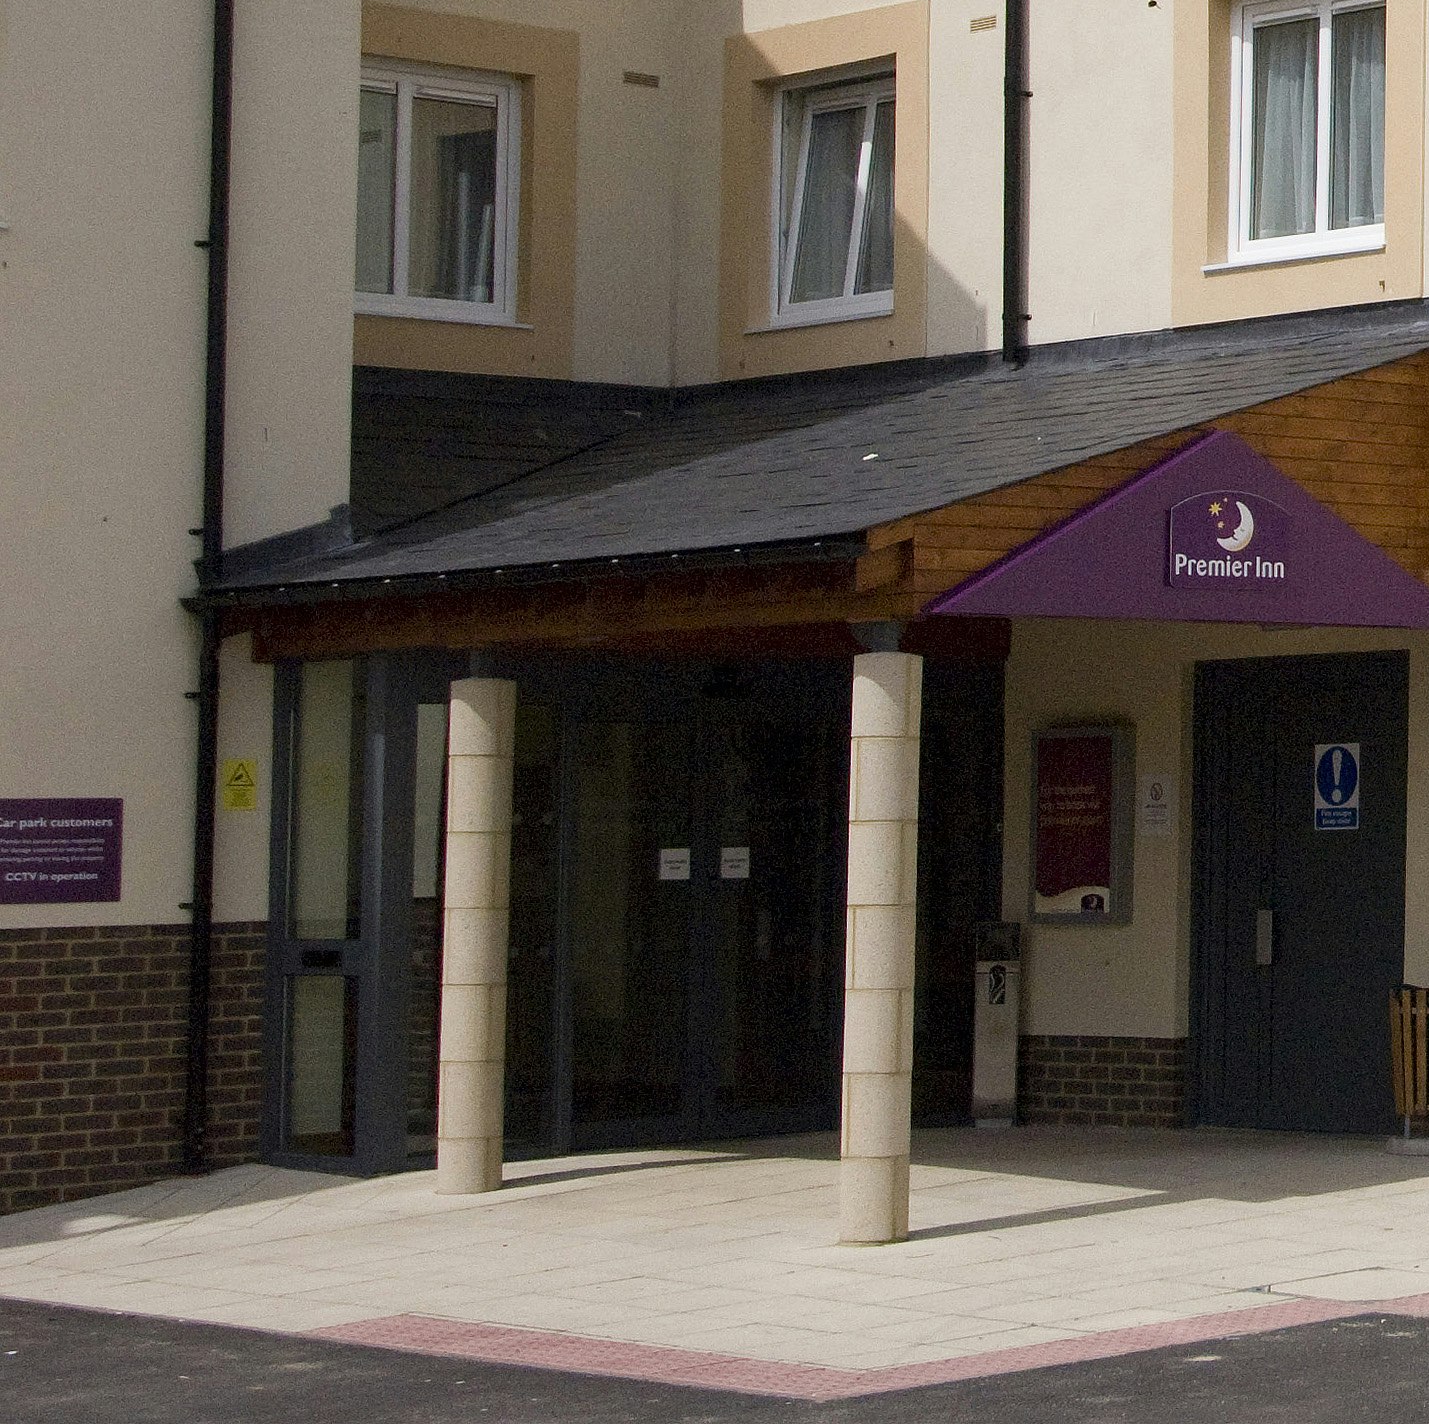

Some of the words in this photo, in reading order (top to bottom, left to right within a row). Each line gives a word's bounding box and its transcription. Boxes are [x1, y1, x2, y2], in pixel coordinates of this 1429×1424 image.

[1174, 552, 1254, 578] Premier
[1255, 555, 1286, 579] Inn
[19, 816, 48, 831] park
[50, 818, 114, 828] customers
[5, 872, 38, 882] CCTV
[39, 872, 49, 881] in
[50, 871, 99, 883] operation
